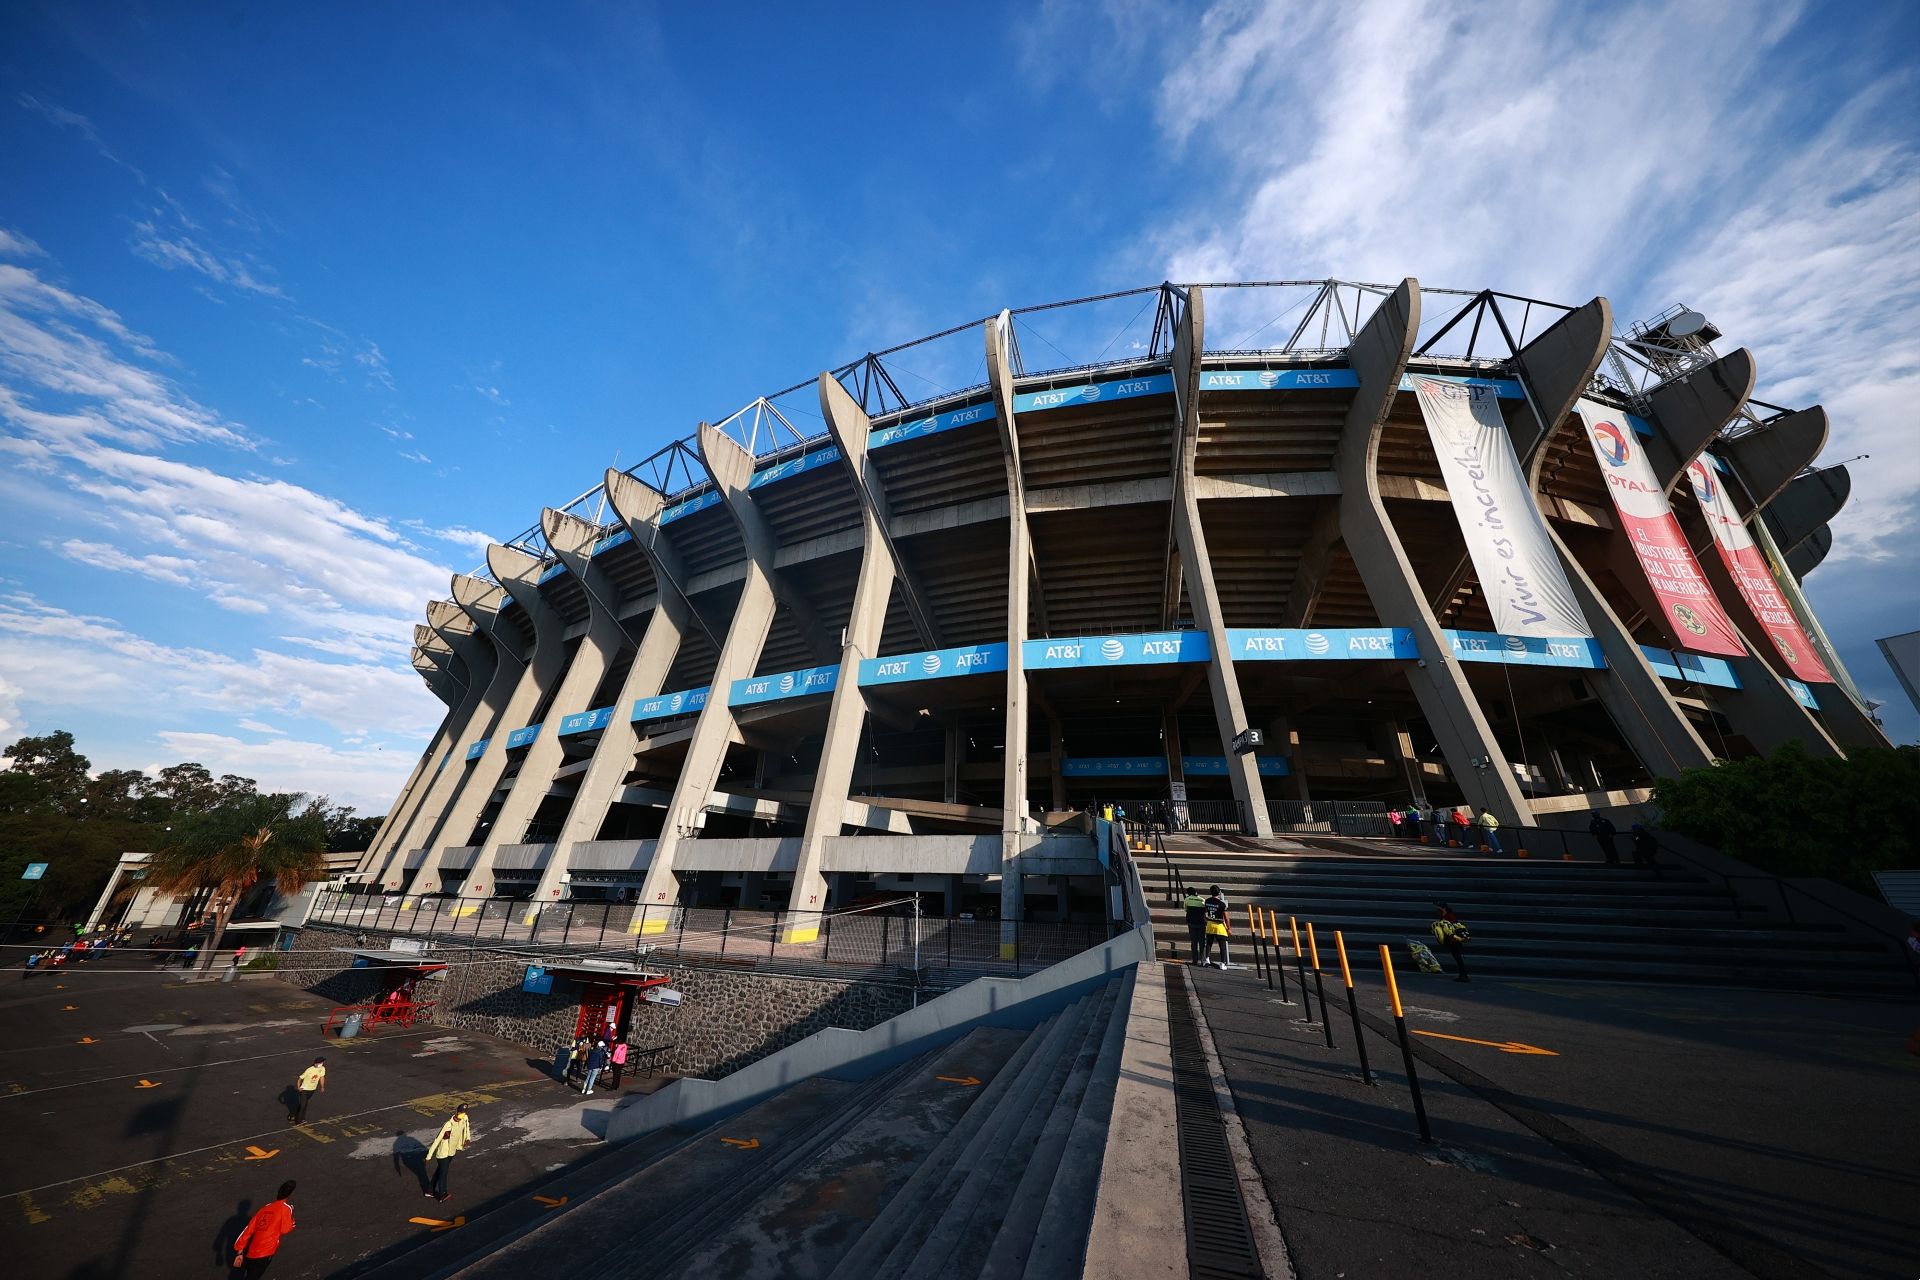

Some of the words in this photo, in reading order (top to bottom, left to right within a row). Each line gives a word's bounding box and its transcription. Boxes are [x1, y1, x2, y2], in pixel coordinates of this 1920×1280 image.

[1208, 375, 1244, 386] AT&T
[1296, 373, 1331, 385] AT&T
[1032, 392, 1067, 407] AT&T
[1116, 381, 1152, 395] AT&T
[882, 426, 909, 442] AT&T
[951, 408, 981, 425] AT&T
[761, 467, 785, 482] AT&T
[815, 448, 839, 464] AT&T
[1493, 538, 1515, 560] es
[1668, 563, 1703, 579] DEL
[1501, 566, 1547, 626] Vivir
[1760, 593, 1787, 609] DEL
[1045, 645, 1084, 659] AT&T
[1142, 640, 1183, 655] AT&T
[1245, 637, 1285, 651] AT&T
[1350, 636, 1391, 650] AT&T
[1453, 638, 1487, 652] AT&T
[1545, 643, 1581, 658] AT&T
[877, 661, 910, 676] AT&T
[956, 652, 990, 668] AT&T
[744, 682, 770, 695] AT&T
[804, 672, 832, 687] AT&T
[642, 701, 662, 713] AT&T
[568, 717, 584, 729] AT&T
[1250, 731, 1259, 742] 3
[552, 889, 560, 897] 19
[657, 892, 666, 900] 20
[809, 895, 817, 904] 21
